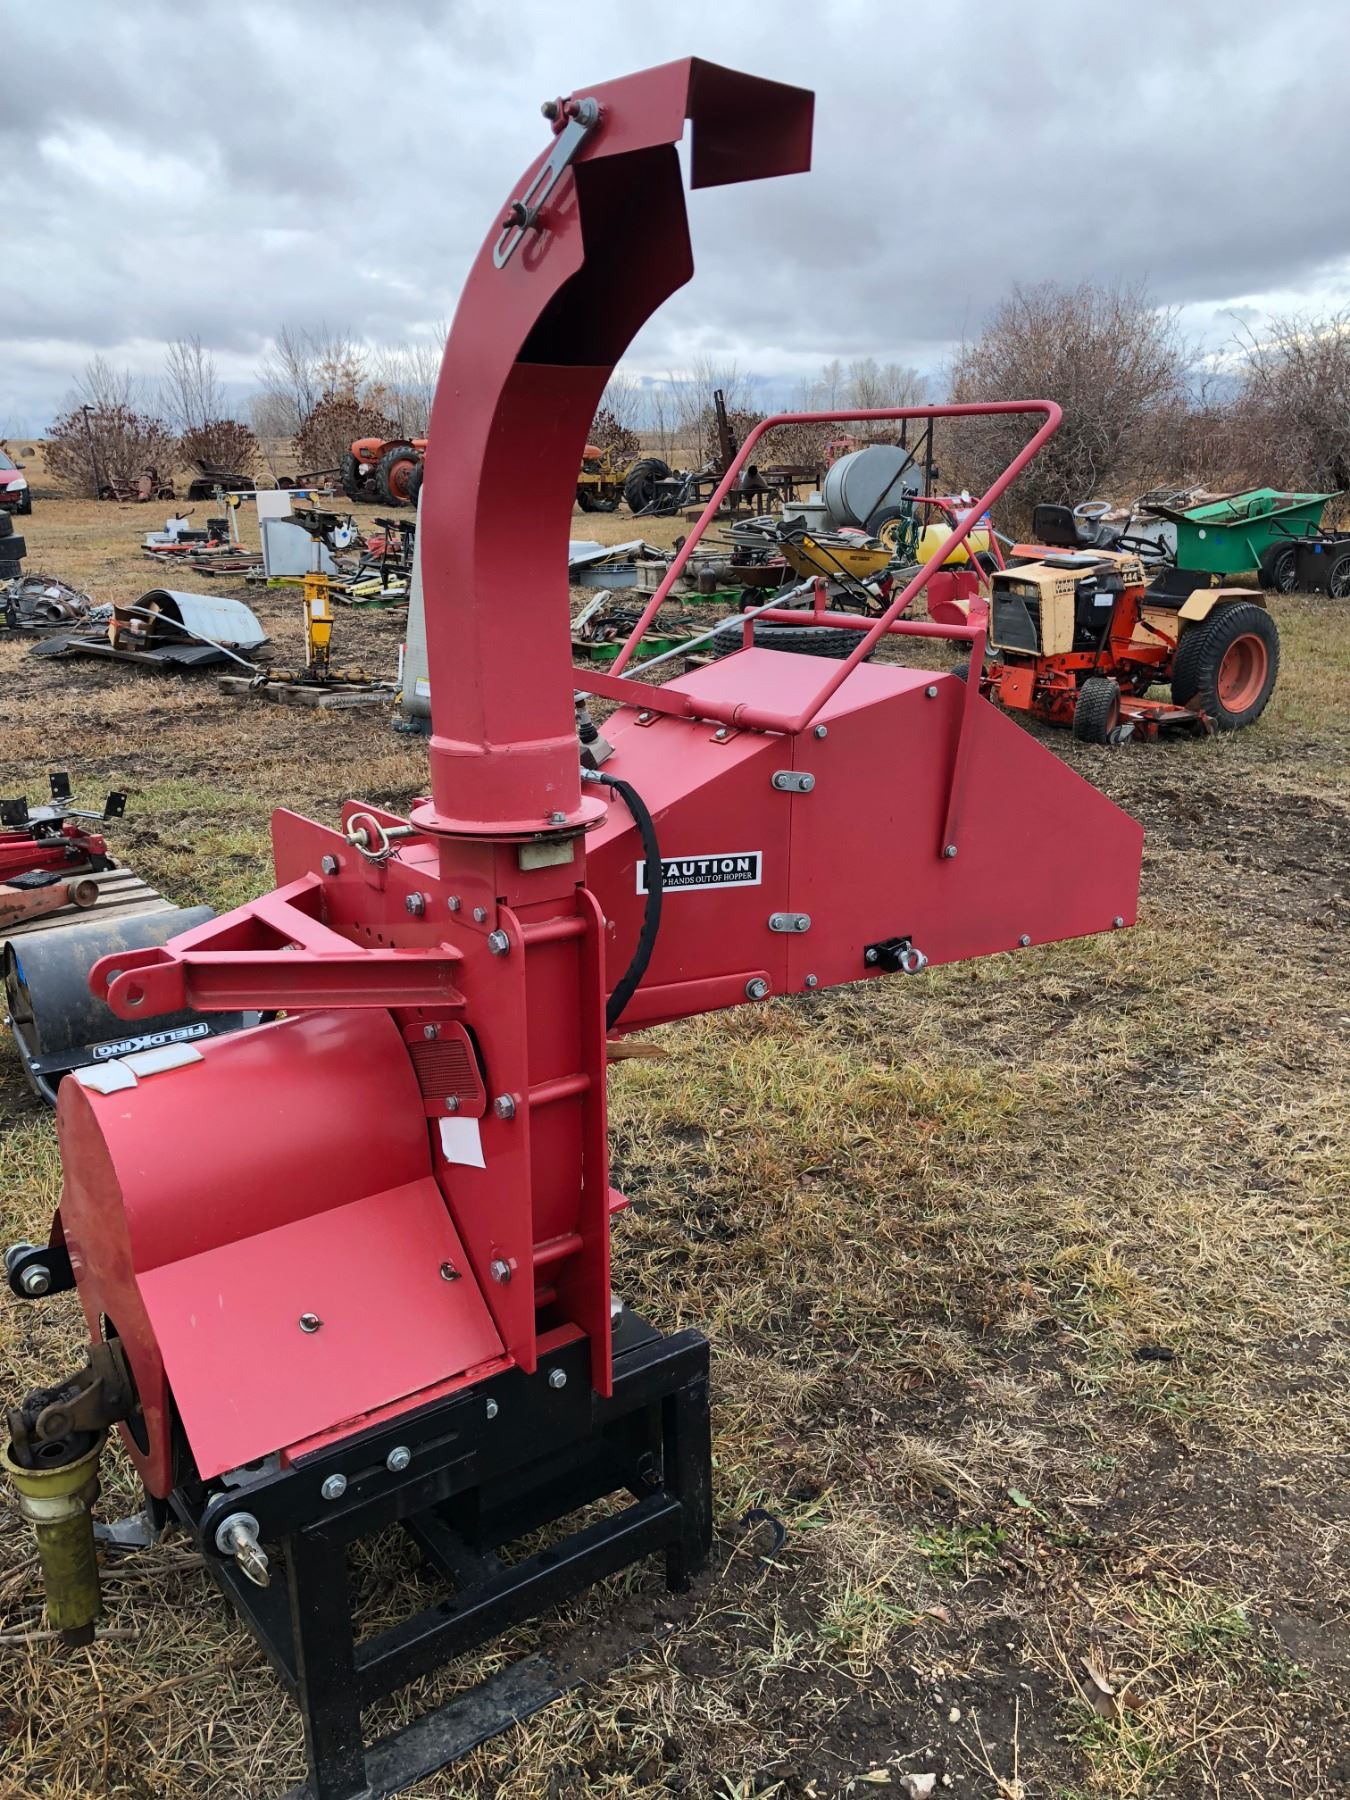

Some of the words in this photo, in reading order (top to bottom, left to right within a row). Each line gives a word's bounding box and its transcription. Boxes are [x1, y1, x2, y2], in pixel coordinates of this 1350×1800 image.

[1123, 572, 1138, 582] 444
[661, 858, 750, 877] AUTION
[668, 877, 695, 886] HANDS
[696, 875, 711, 884] OUT
[712, 874, 723, 882] OF
[723, 872, 752, 881] HOPPER
[98, 1025, 205, 1056] FIELDKING
